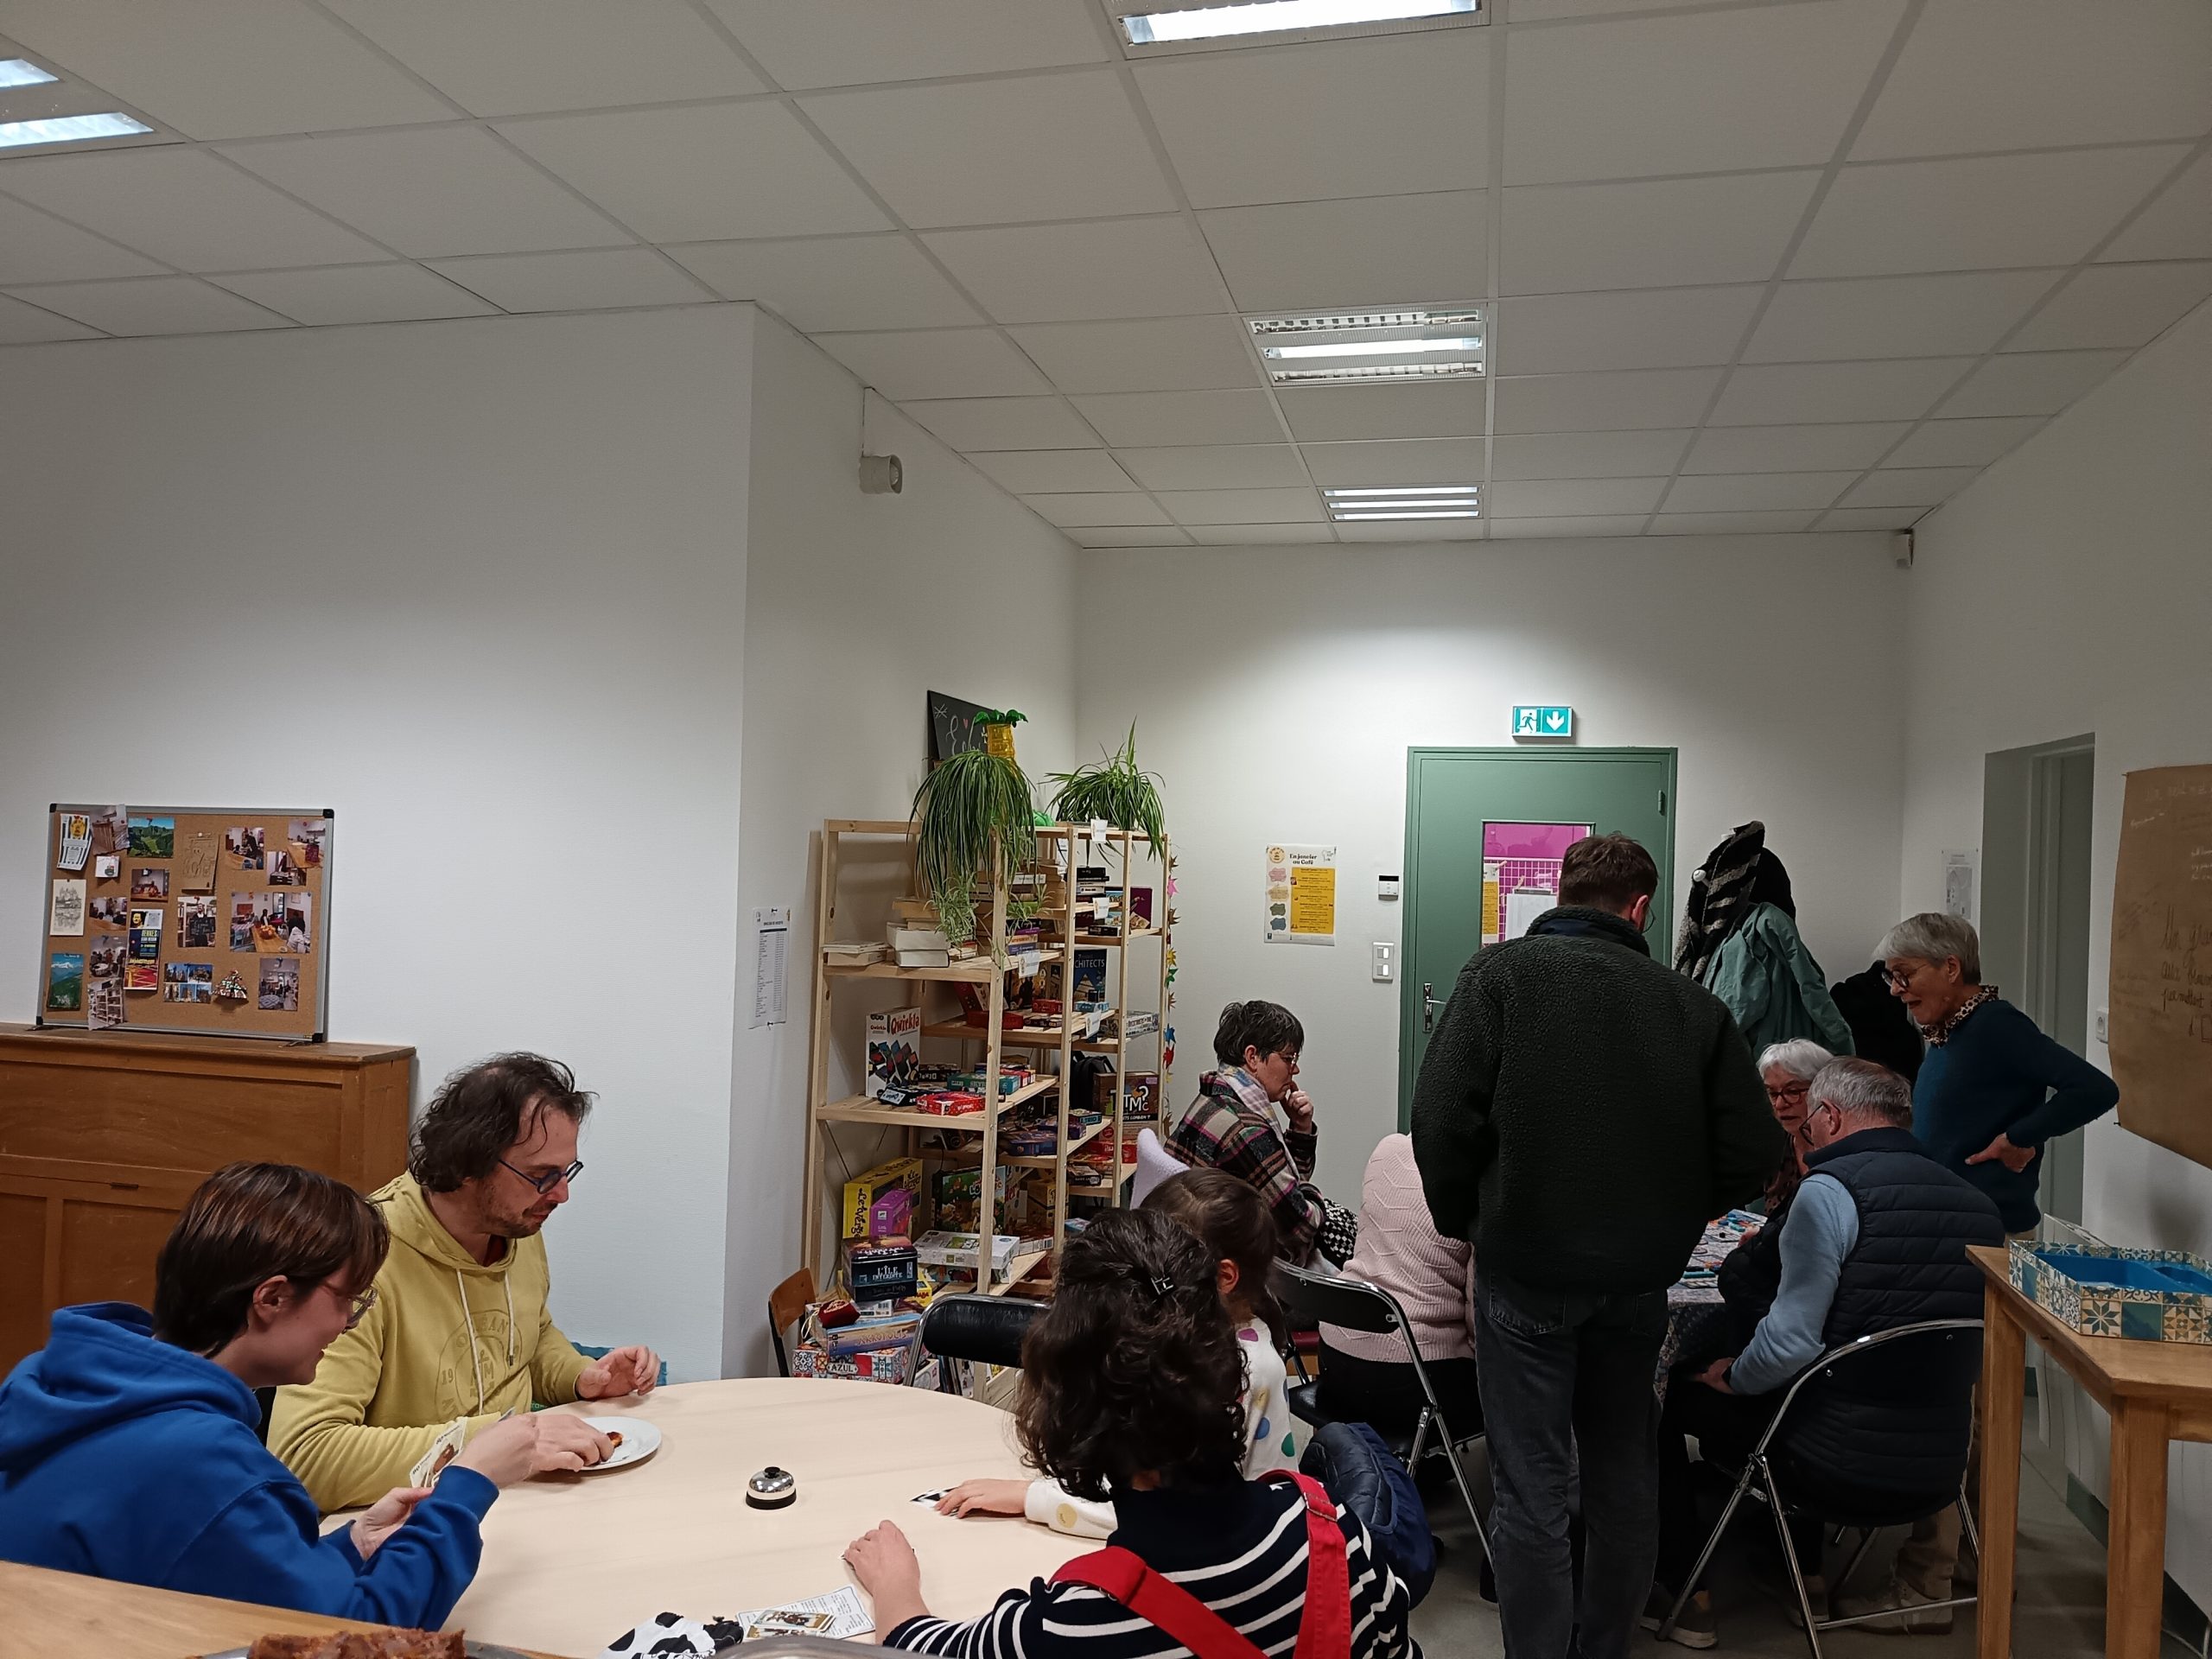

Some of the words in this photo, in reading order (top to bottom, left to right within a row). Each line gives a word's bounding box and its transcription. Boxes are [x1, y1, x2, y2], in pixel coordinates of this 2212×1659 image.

[1074, 959, 1105, 969] CHITECTS
[891, 1012, 920, 1035] Qwirkle
[830, 1364, 854, 1373] AZUL
[442, 1368, 454, 1385] 19
